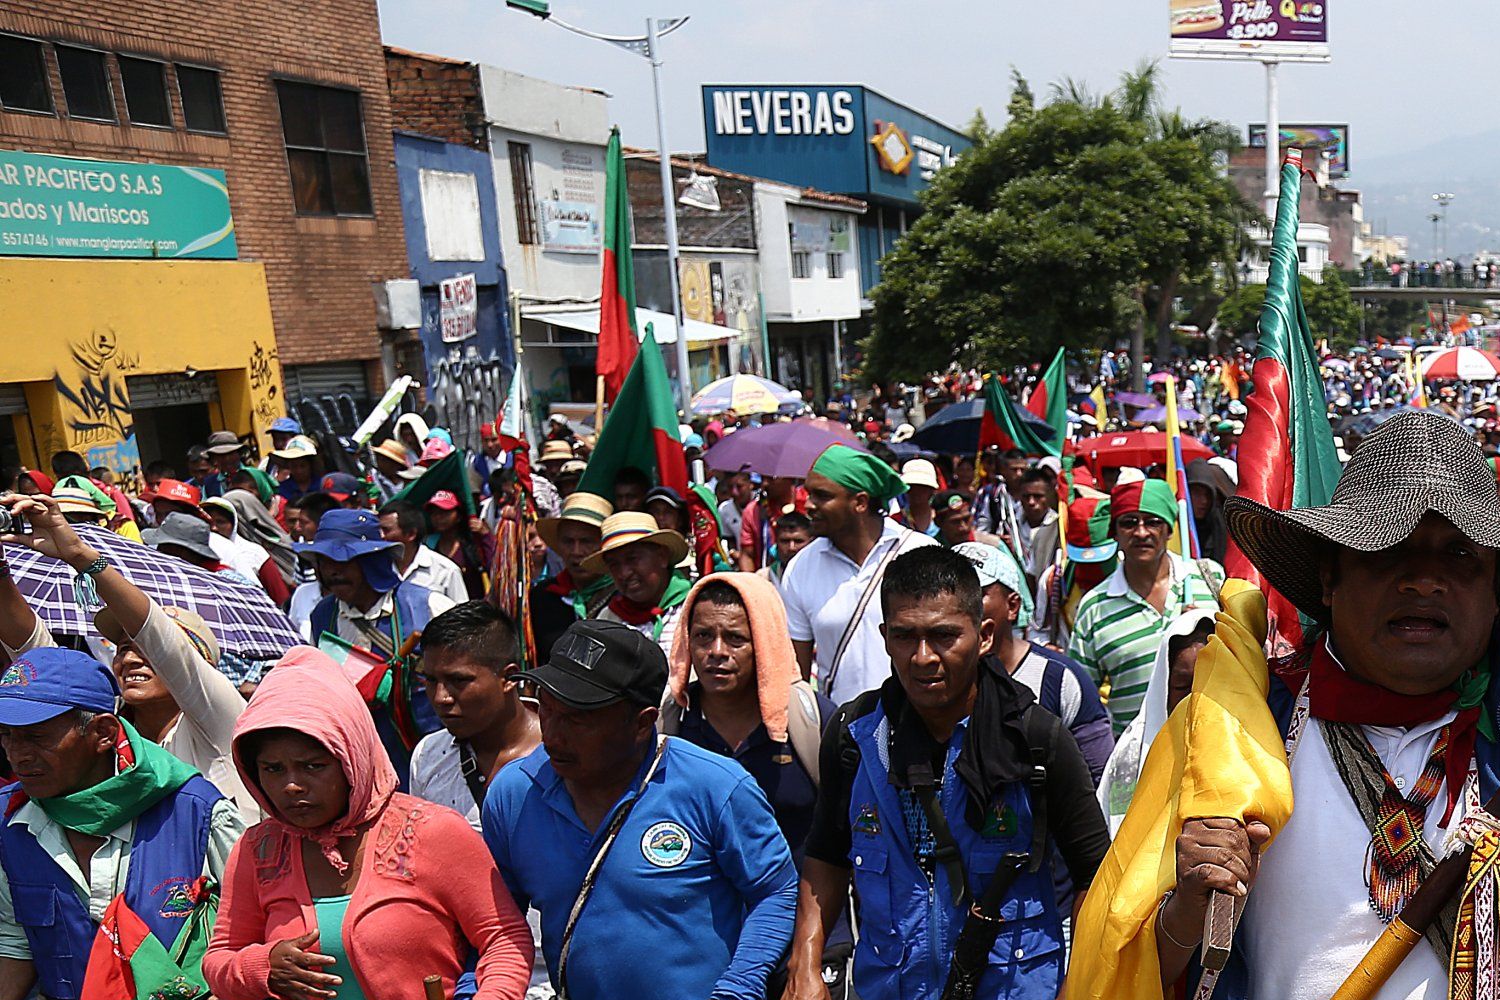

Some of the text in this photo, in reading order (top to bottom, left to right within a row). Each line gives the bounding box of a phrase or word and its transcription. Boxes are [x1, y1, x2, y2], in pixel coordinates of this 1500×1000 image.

[712, 90, 854, 135] NEVERAS
[0, 163, 163, 196] AR PACIFICO S.A.S
[51, 204, 63, 226] y
[68, 201, 150, 226] Mariscos
[2, 231, 49, 248] 5574746
